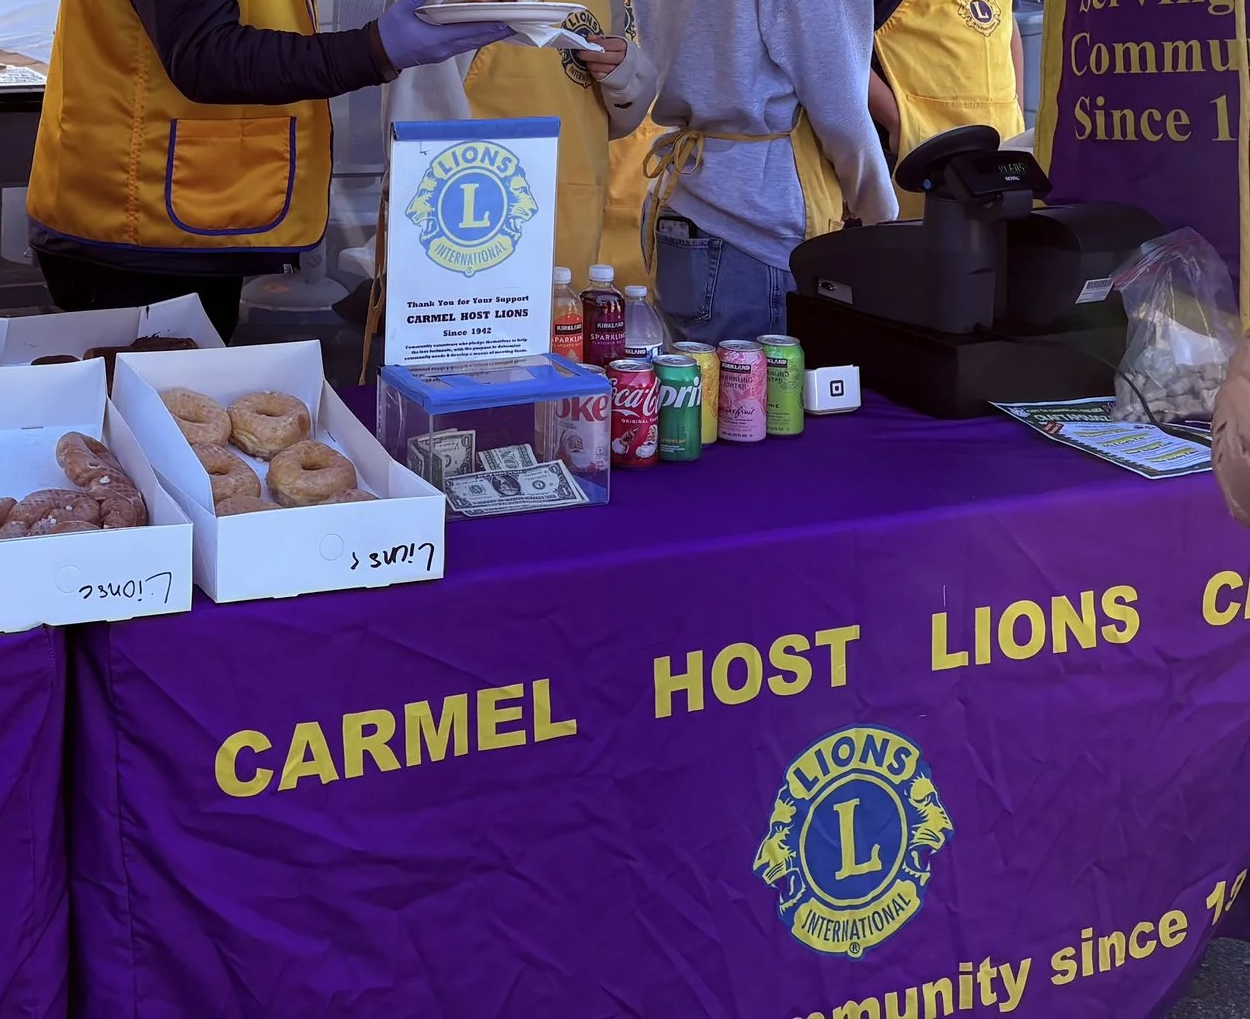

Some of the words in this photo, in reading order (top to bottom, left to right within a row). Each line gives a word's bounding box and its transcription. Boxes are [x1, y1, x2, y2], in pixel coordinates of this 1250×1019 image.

[568, 12, 598, 31] LIONS
[1071, 32, 1250, 77] Commu
[1074, 96, 1192, 142] Since
[438, 147, 514, 176] LIONS
[458, 183, 490, 228] L
[433, 241, 508, 267] INTERNATIONAL
[407, 314, 456, 324] CARMEL
[461, 311, 490, 321] HOST
[494, 309, 529, 319] LIONS
[438, 299, 454, 307] You
[472, 297, 493, 305] Your
[495, 295, 529, 304] Support
[471, 327, 492, 335] 1942
[215, 679, 577, 799] CARMEL
[653, 624, 860, 719] HOST
[931, 585, 1140, 672] LIONS
[793, 734, 907, 793] LIONS
[833, 798, 882, 880] L
[801, 892, 912, 943] INTERNATIONAL
[1050, 908, 1188, 985] since
